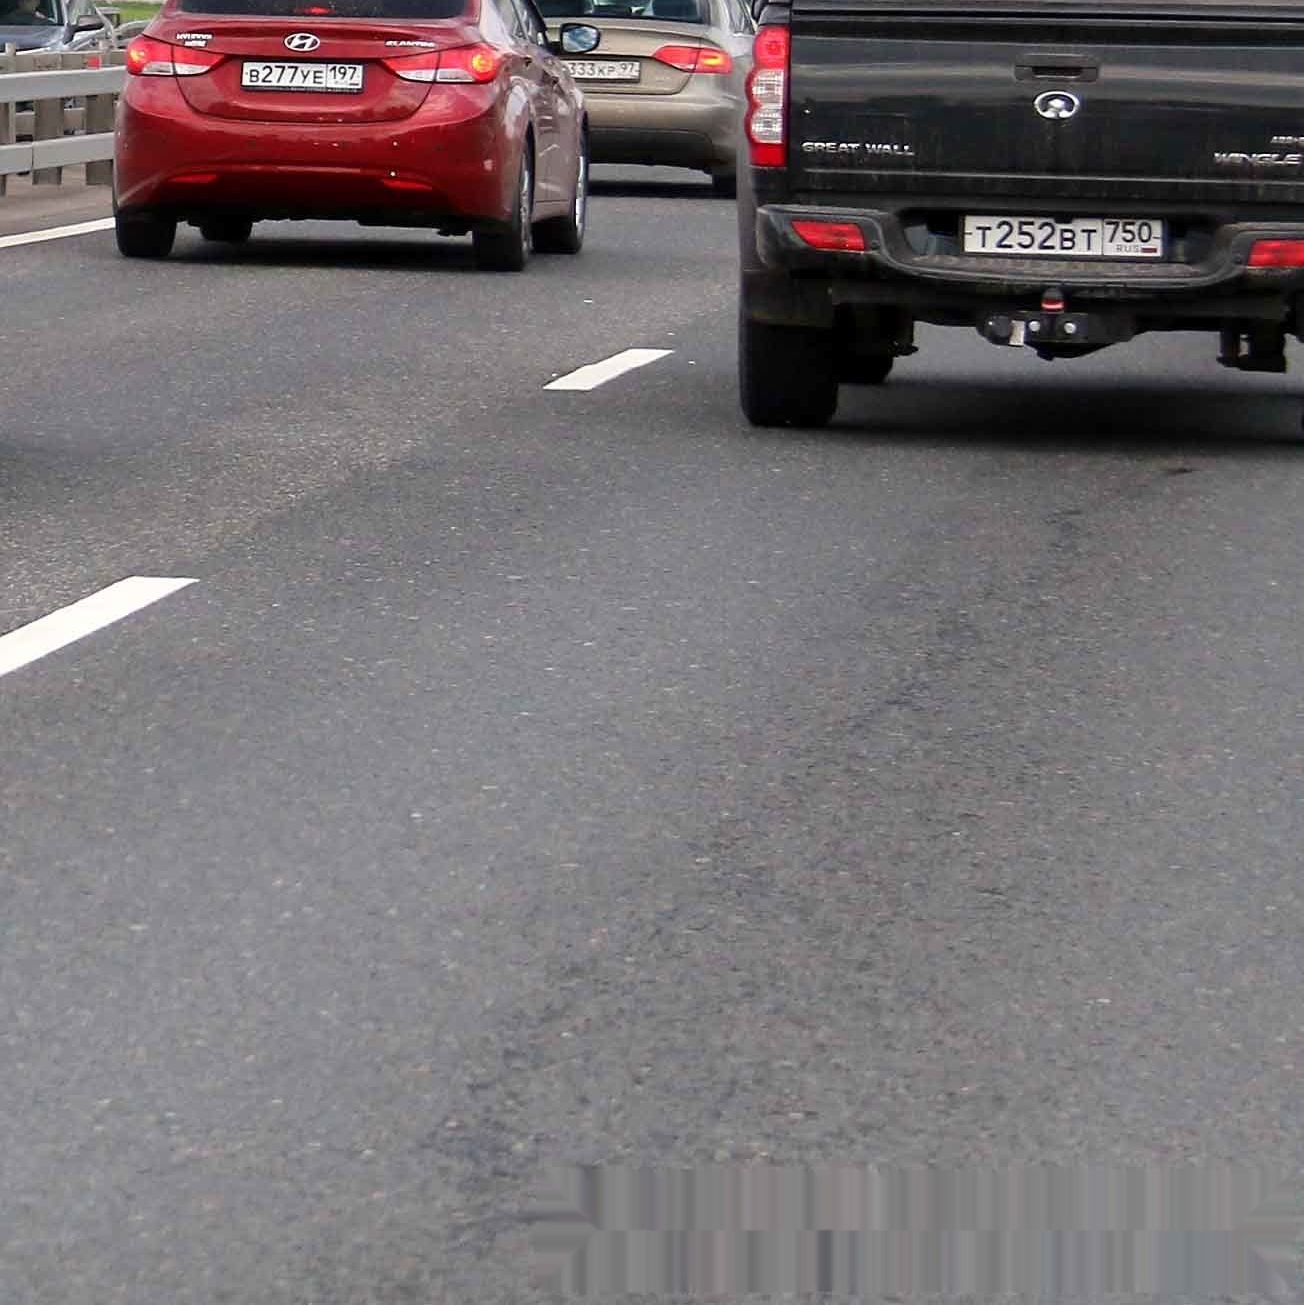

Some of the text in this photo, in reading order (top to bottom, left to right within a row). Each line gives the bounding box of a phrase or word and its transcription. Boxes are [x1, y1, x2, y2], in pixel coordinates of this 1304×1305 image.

[249, 65, 357, 85] В277УЕ 197
[560, 62, 616, 76] 333КР
[802, 141, 915, 156] GREAT WALL
[976, 220, 1152, 250] Т252ВТ 750
